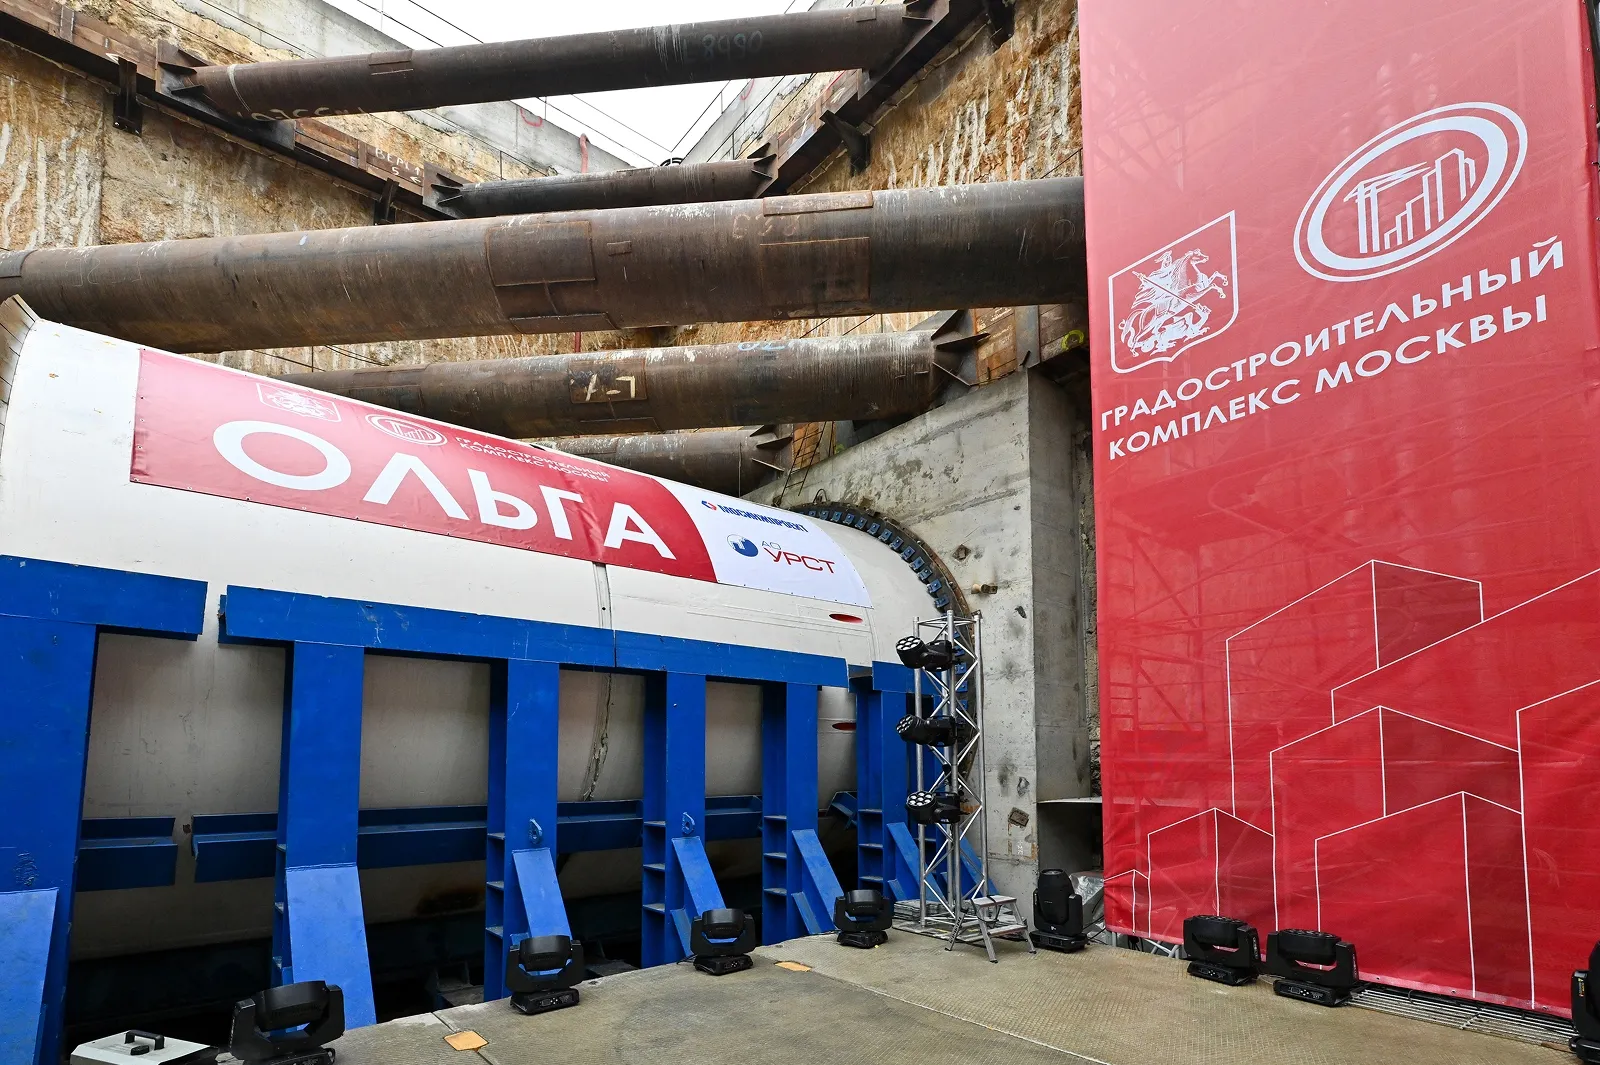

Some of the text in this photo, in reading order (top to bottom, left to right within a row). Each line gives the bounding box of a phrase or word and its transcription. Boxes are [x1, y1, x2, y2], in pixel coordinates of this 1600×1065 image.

[1101, 235, 1564, 431] ГРАДОСТРОИТЕЛЬНЫЙ
[1109, 294, 1547, 461] КОМПЛЕКС МОСКВЫ
[212, 419, 677, 561] ОЛЬГА
[455, 436, 611, 479] ГРАДОСТРОИТЕЛЬНЫЙ
[459, 442, 610, 483] КОМПЛЕКС МОСКВЫ
[763, 547, 836, 574] УРСТ
